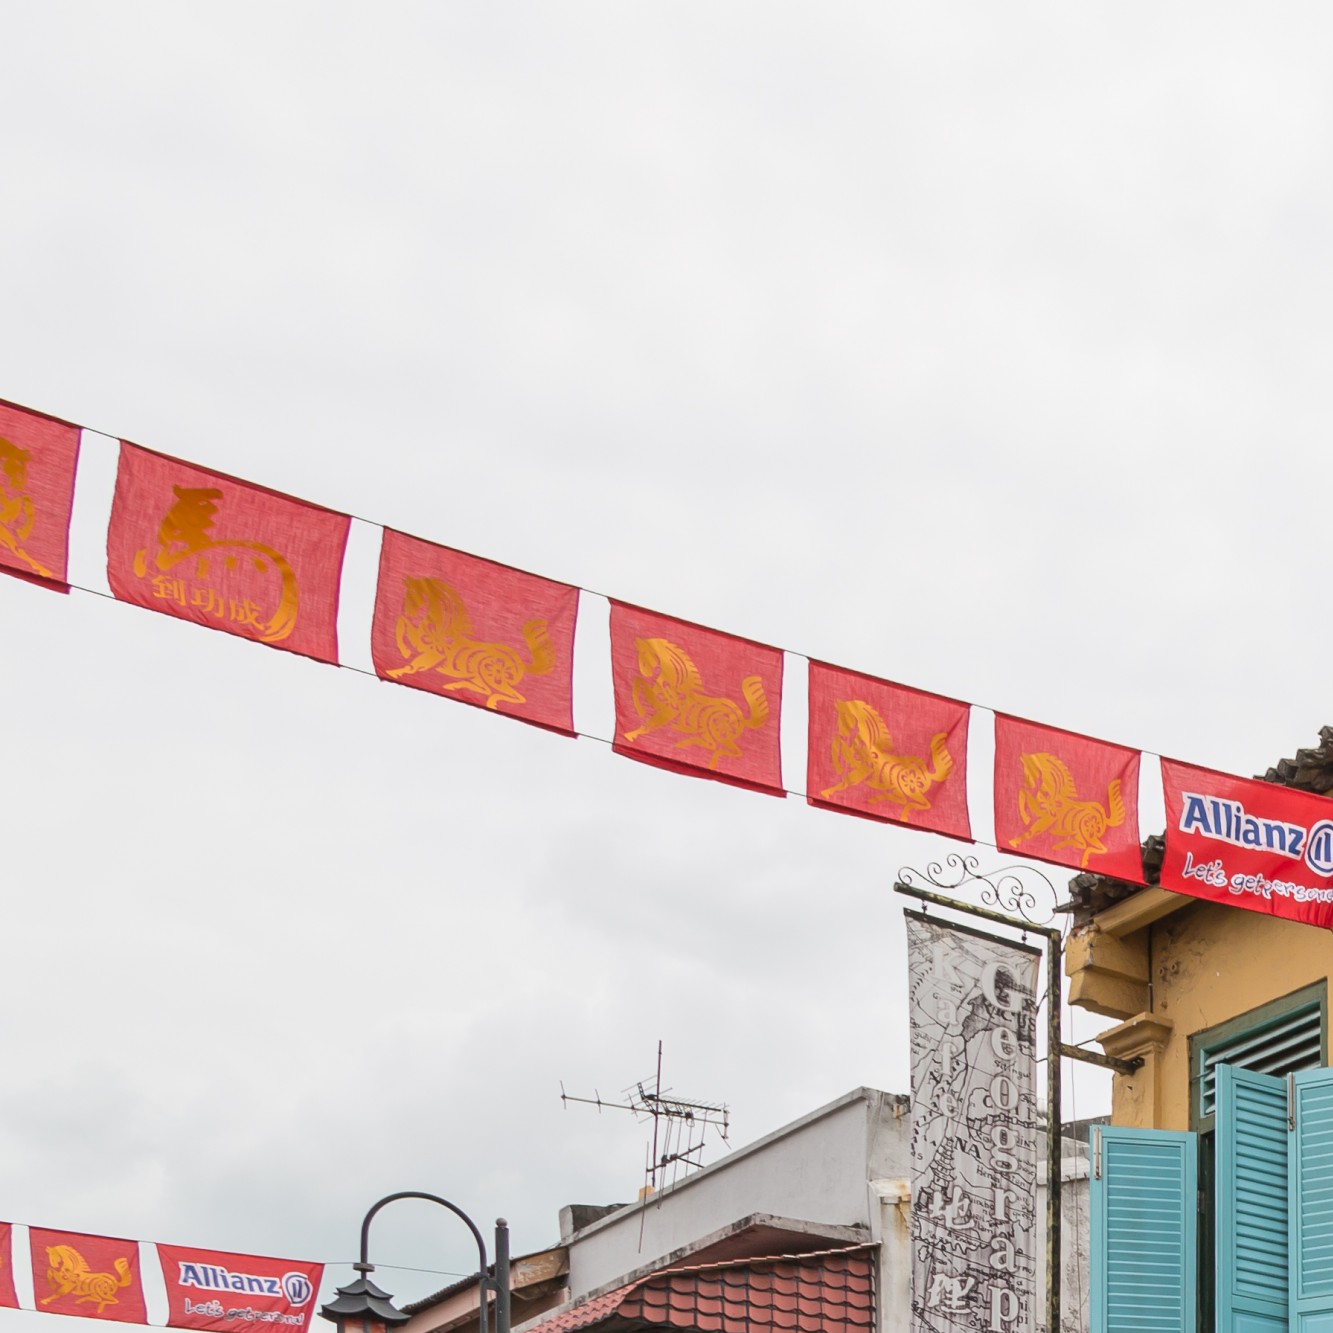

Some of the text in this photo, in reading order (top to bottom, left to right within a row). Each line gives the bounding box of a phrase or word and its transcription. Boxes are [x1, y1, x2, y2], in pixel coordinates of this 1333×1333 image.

[1181, 793, 1306, 858] Allianz
[1183, 853, 1227, 887] Let's
[1230, 873, 1264, 896] get
[180, 1262, 282, 1296] Allianz
[185, 1299, 224, 1317] Let's
